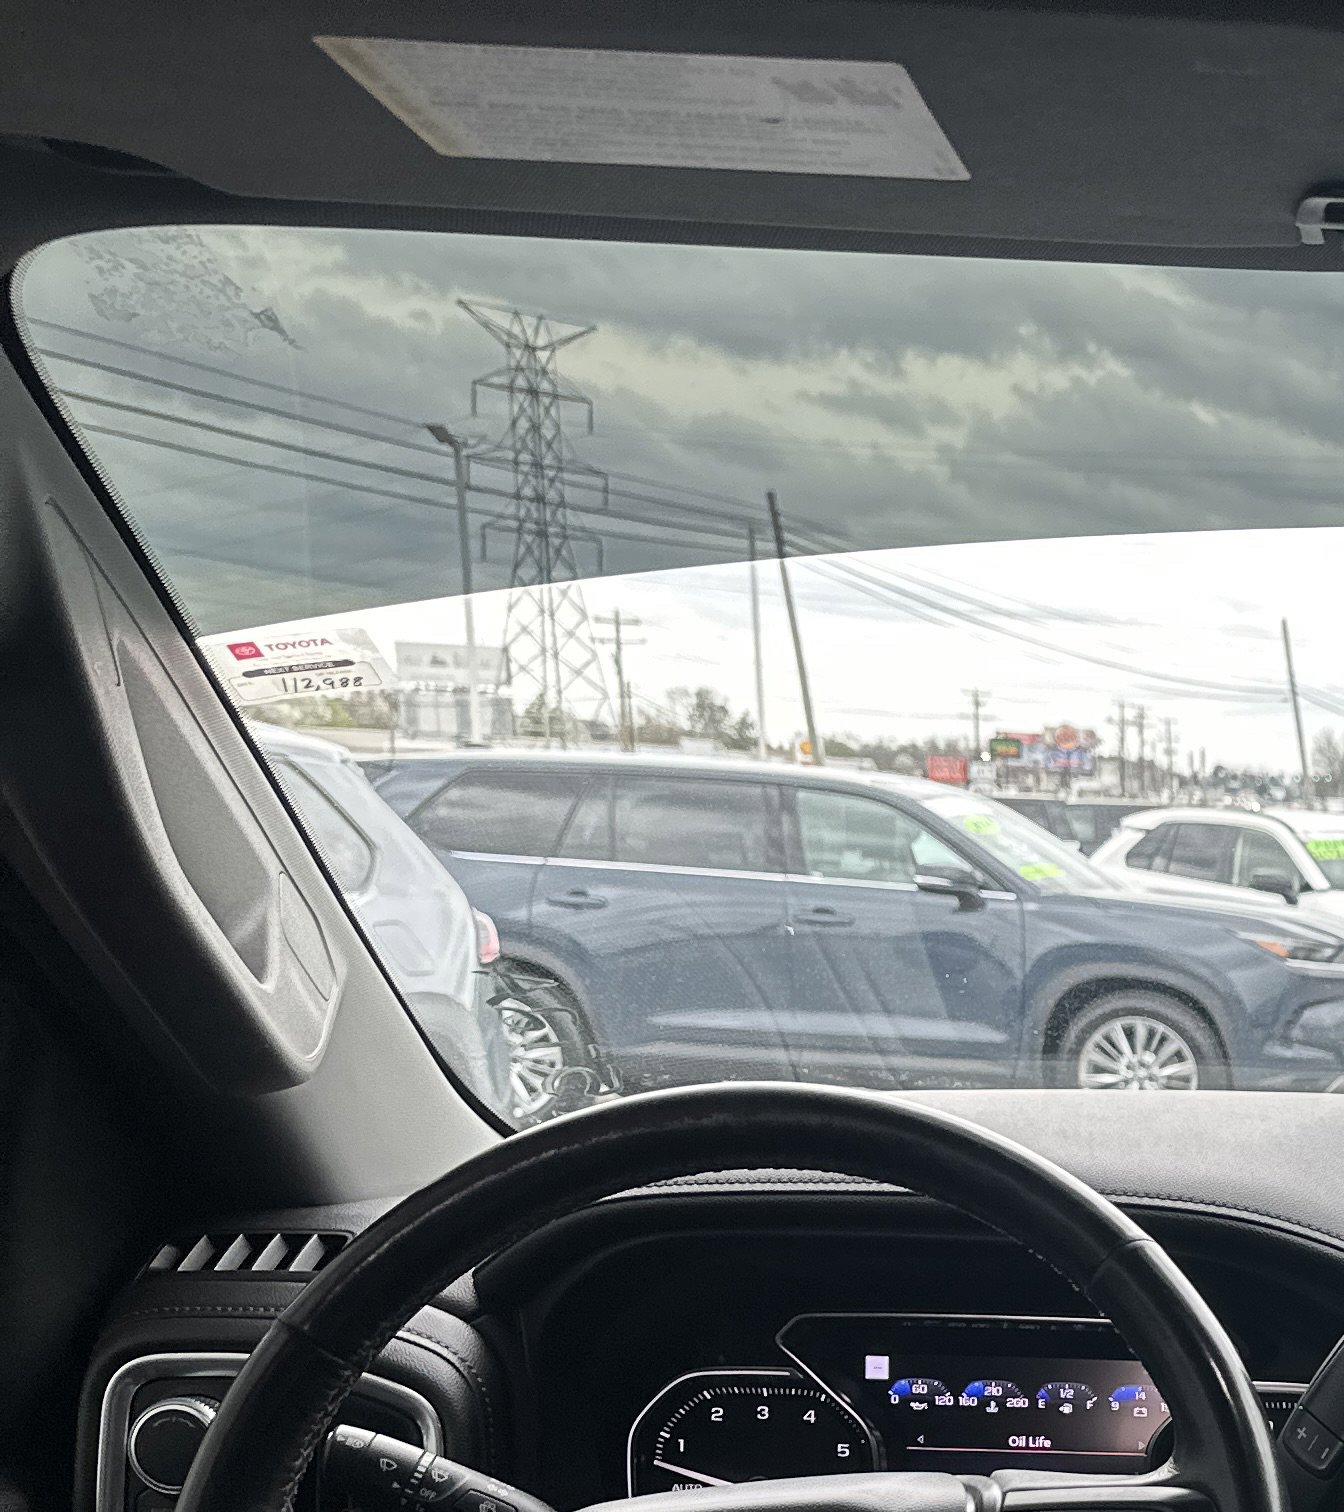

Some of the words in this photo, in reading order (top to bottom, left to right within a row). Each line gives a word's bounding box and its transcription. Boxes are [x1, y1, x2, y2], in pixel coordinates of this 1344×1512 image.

[264, 637, 334, 652] TOYOTA
[281, 676, 364, 694] 112,988
[911, 1384, 928, 1395] 60
[1059, 1388, 1074, 1399] 1/2
[890, 1394, 900, 1404] 0
[935, 1396, 954, 1406] 120
[958, 1397, 978, 1407] 160
[1006, 1398, 1029, 1408] 260
[1038, 1398, 1046, 1409] E
[1110, 1401, 1119, 1411] 9
[677, 1438, 685, 1453] 1
[711, 1407, 724, 1422] 2
[756, 1405, 769, 1420] 3
[802, 1409, 816, 1424] 4
[837, 1443, 850, 1458] 5
[1008, 1436, 1026, 1448] Oil
[1028, 1436, 1052, 1448] Life
